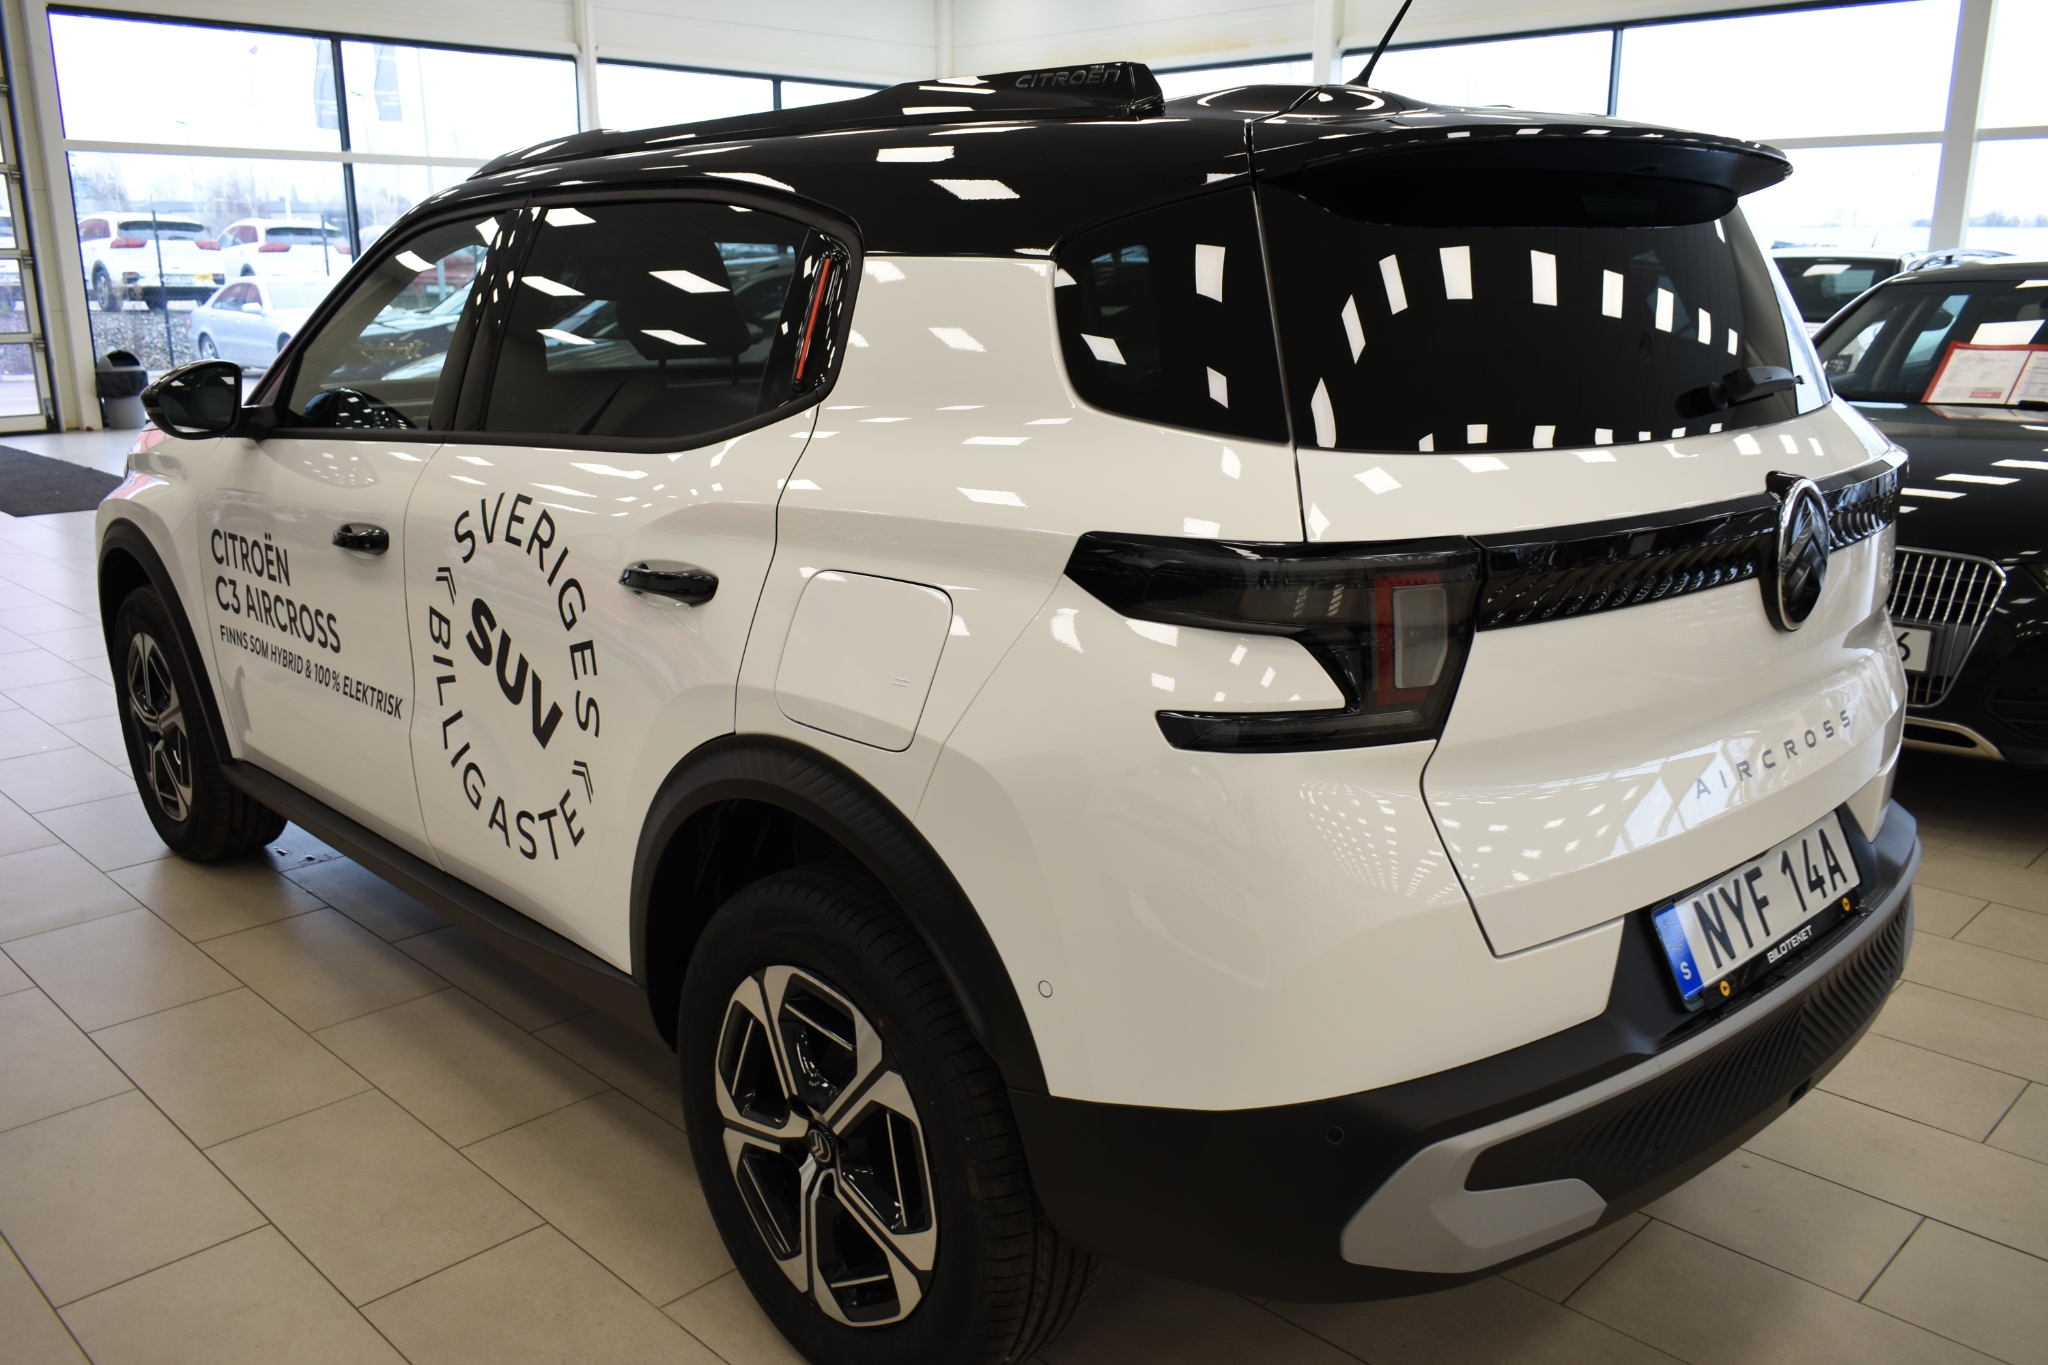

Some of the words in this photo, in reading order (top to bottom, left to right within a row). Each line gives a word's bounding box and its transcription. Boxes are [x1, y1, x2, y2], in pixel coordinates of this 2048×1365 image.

[211, 528, 291, 587] CITROËN
[215, 575, 241, 615] C3
[246, 584, 341, 654] AIRCROSS
[453, 492, 600, 738] SVERIGES
[219, 624, 249, 650] FINNS
[249, 634, 269, 660] SOM
[270, 643, 304, 675] HYBRID
[305, 659, 312, 679] &
[342, 675, 403, 720] ELEKTRISK
[465, 597, 564, 750] SUV
[428, 605, 586, 861] BILLIGASTE
[1696, 709, 1851, 799] AIRCROSS
[1693, 865, 1770, 969] NYF
[1780, 828, 1848, 913] 14A
[1680, 961, 1692, 981] S
